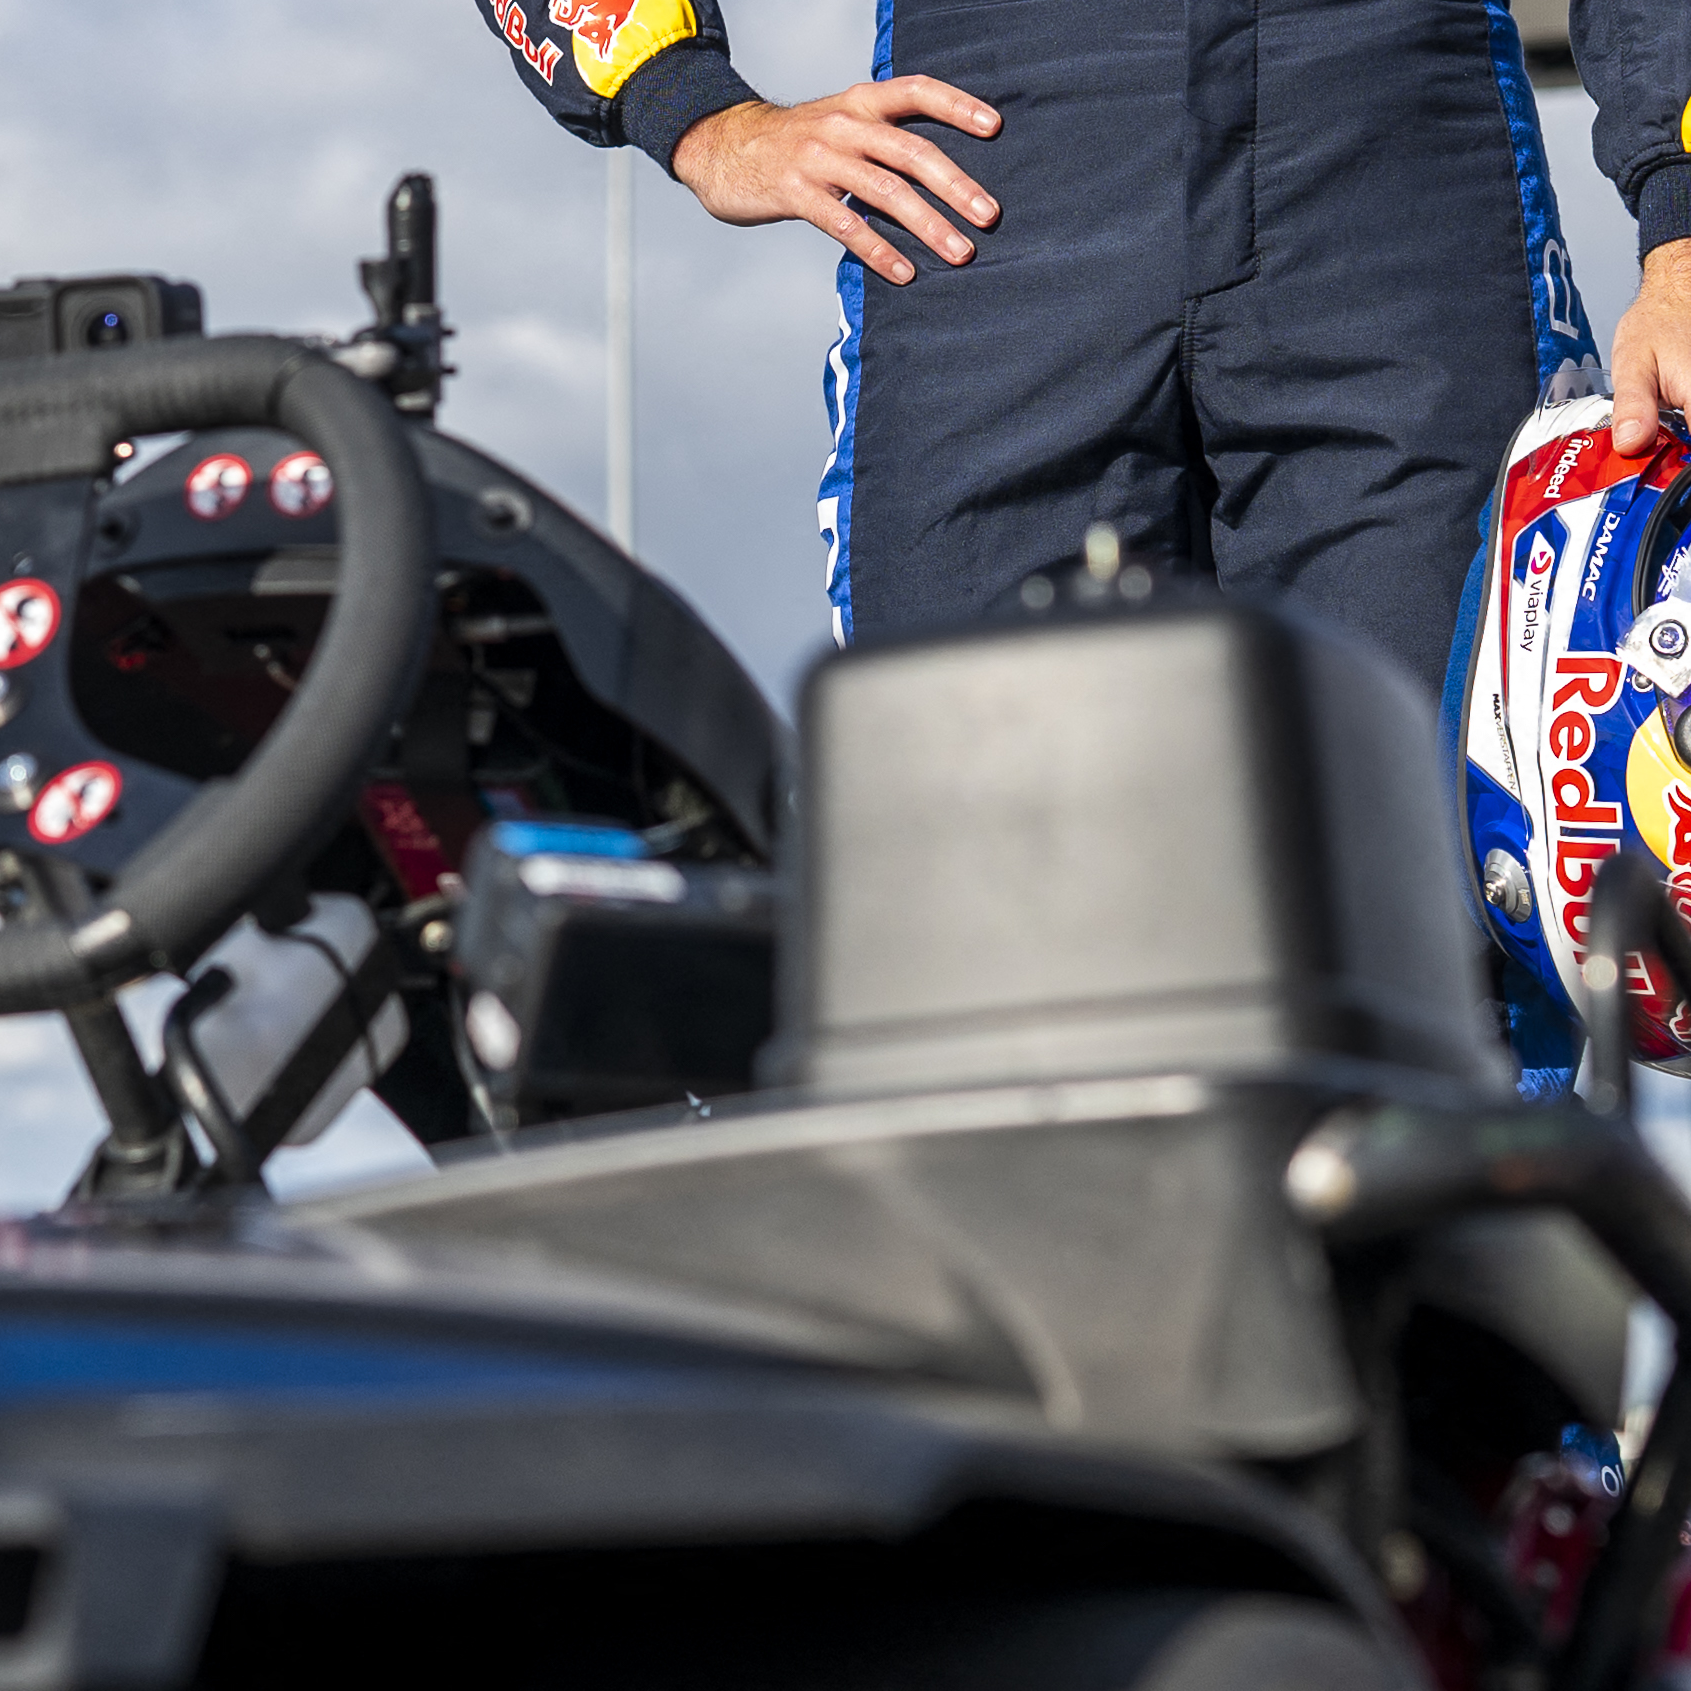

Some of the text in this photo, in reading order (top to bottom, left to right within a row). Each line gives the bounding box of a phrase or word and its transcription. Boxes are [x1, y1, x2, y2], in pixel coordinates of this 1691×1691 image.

[504, 3, 563, 85] Bull
[1543, 437, 1591, 499] indeed
[1582, 512, 1621, 602] DAMAC
[1520, 579, 1543, 652] viaplay
[1550, 657, 1624, 824] Red
